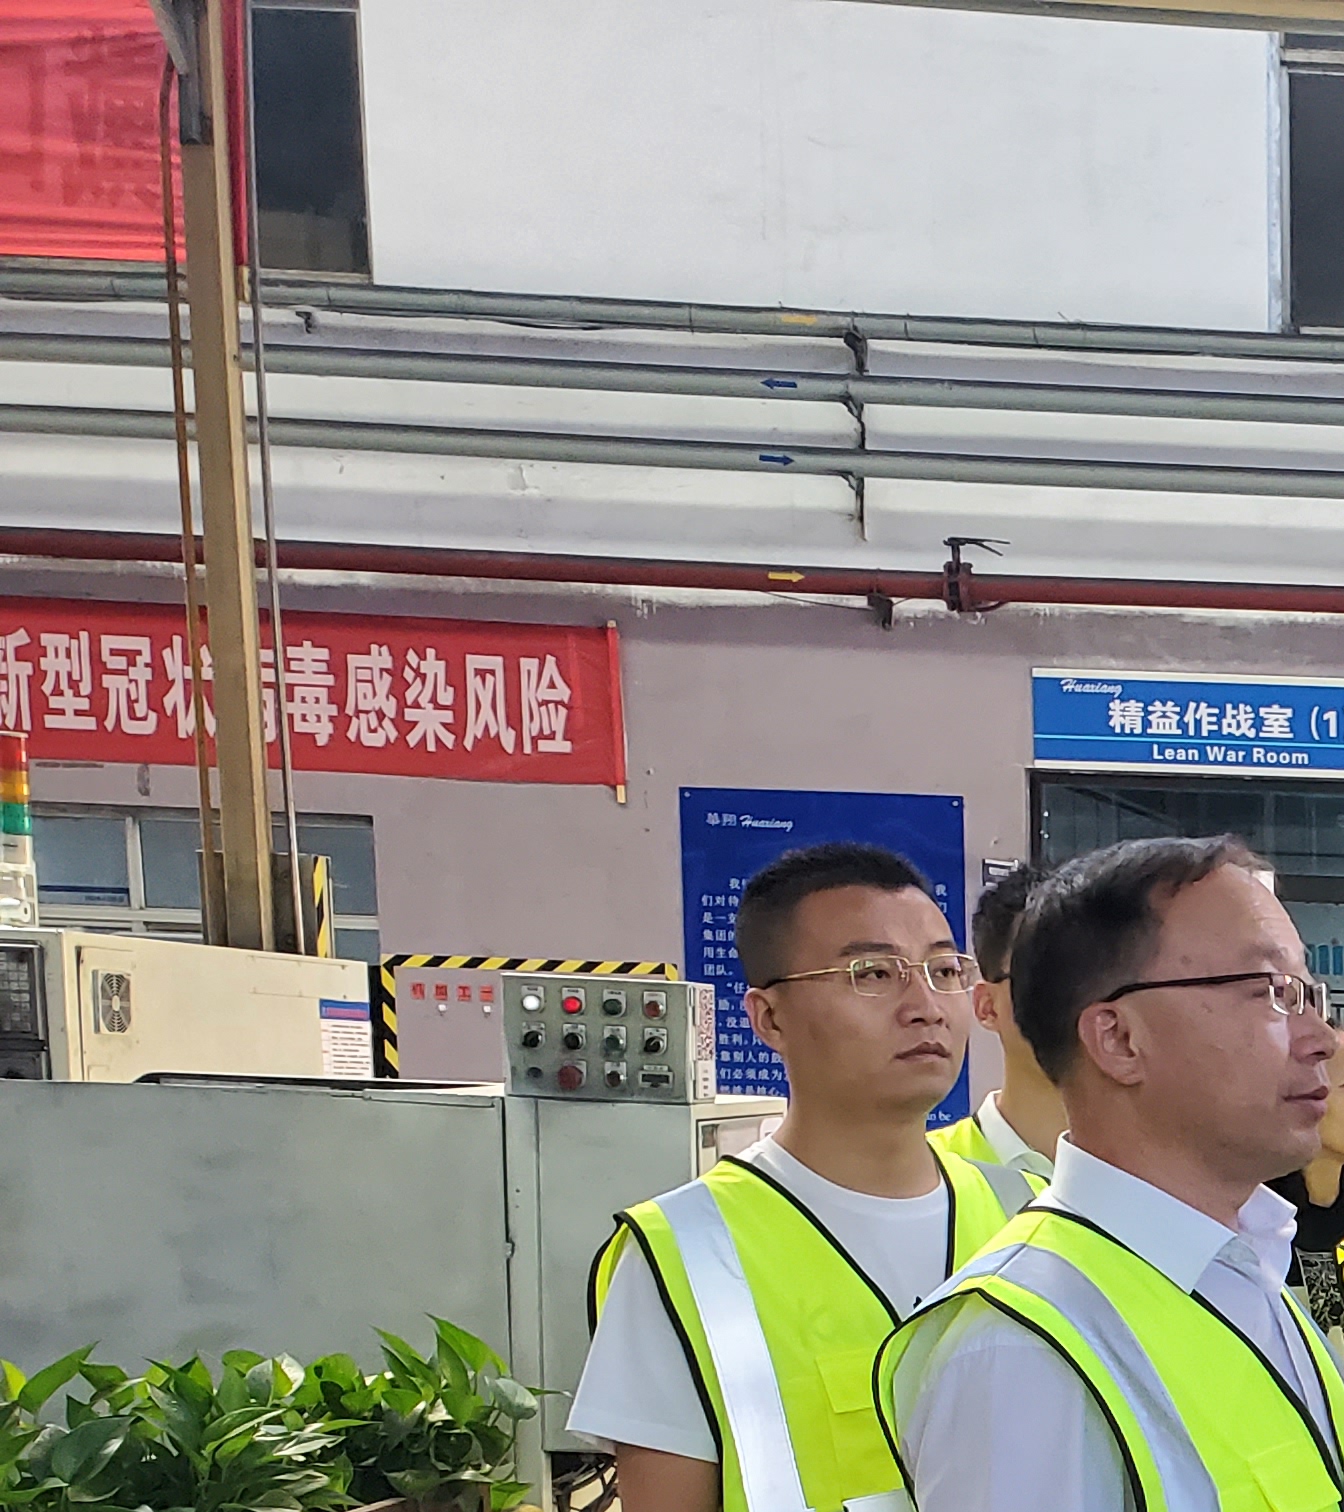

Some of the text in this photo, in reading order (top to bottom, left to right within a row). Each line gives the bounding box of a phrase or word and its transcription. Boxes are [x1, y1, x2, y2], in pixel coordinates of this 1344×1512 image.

[1060, 678, 1123, 697] Huaxiang
[1108, 700, 1294, 739] 精益作战室
[1153, 744, 1309, 765] Lean War Room
